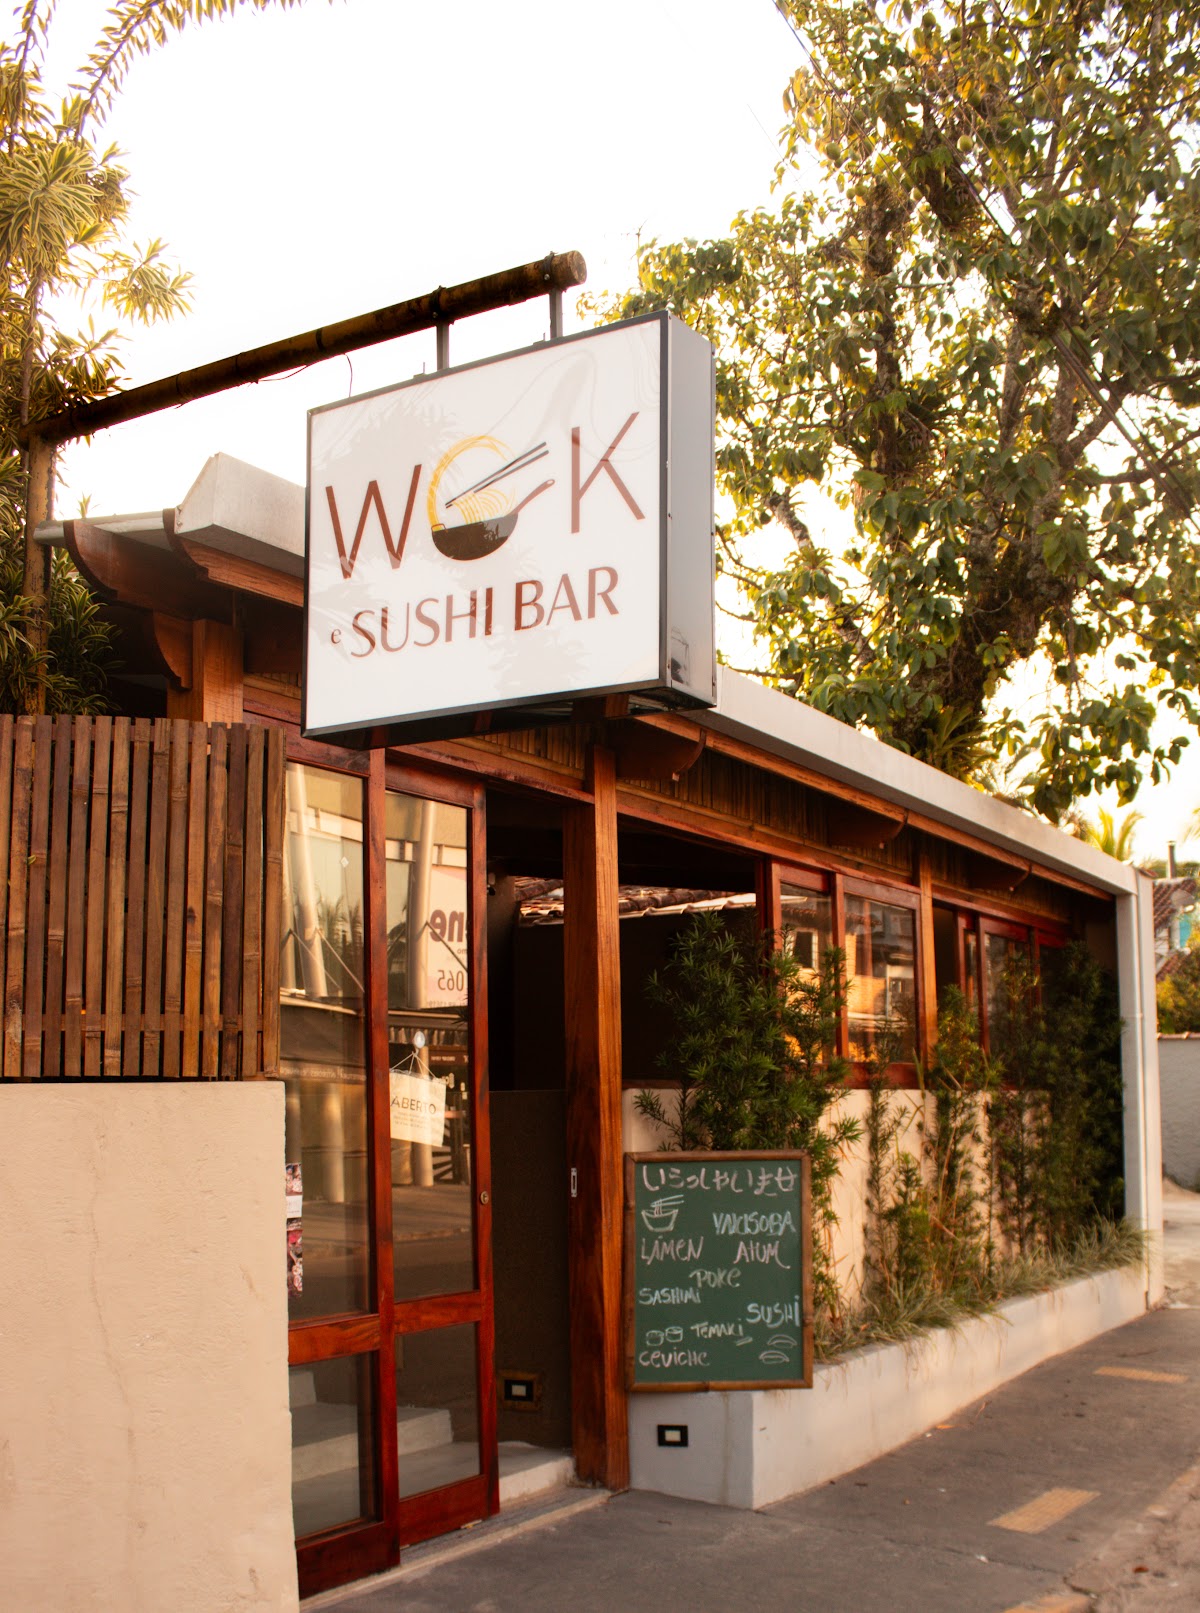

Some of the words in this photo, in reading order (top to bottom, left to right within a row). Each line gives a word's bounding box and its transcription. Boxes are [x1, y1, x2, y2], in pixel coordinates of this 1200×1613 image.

[351, 587, 493, 658] SUSHI
[514, 566, 620, 632] BAR
[390, 1095, 437, 1115] ABERTO
[643, 1165, 798, 1197] いらっしゃいませ
[713, 1211, 797, 1236] YAKISOBA
